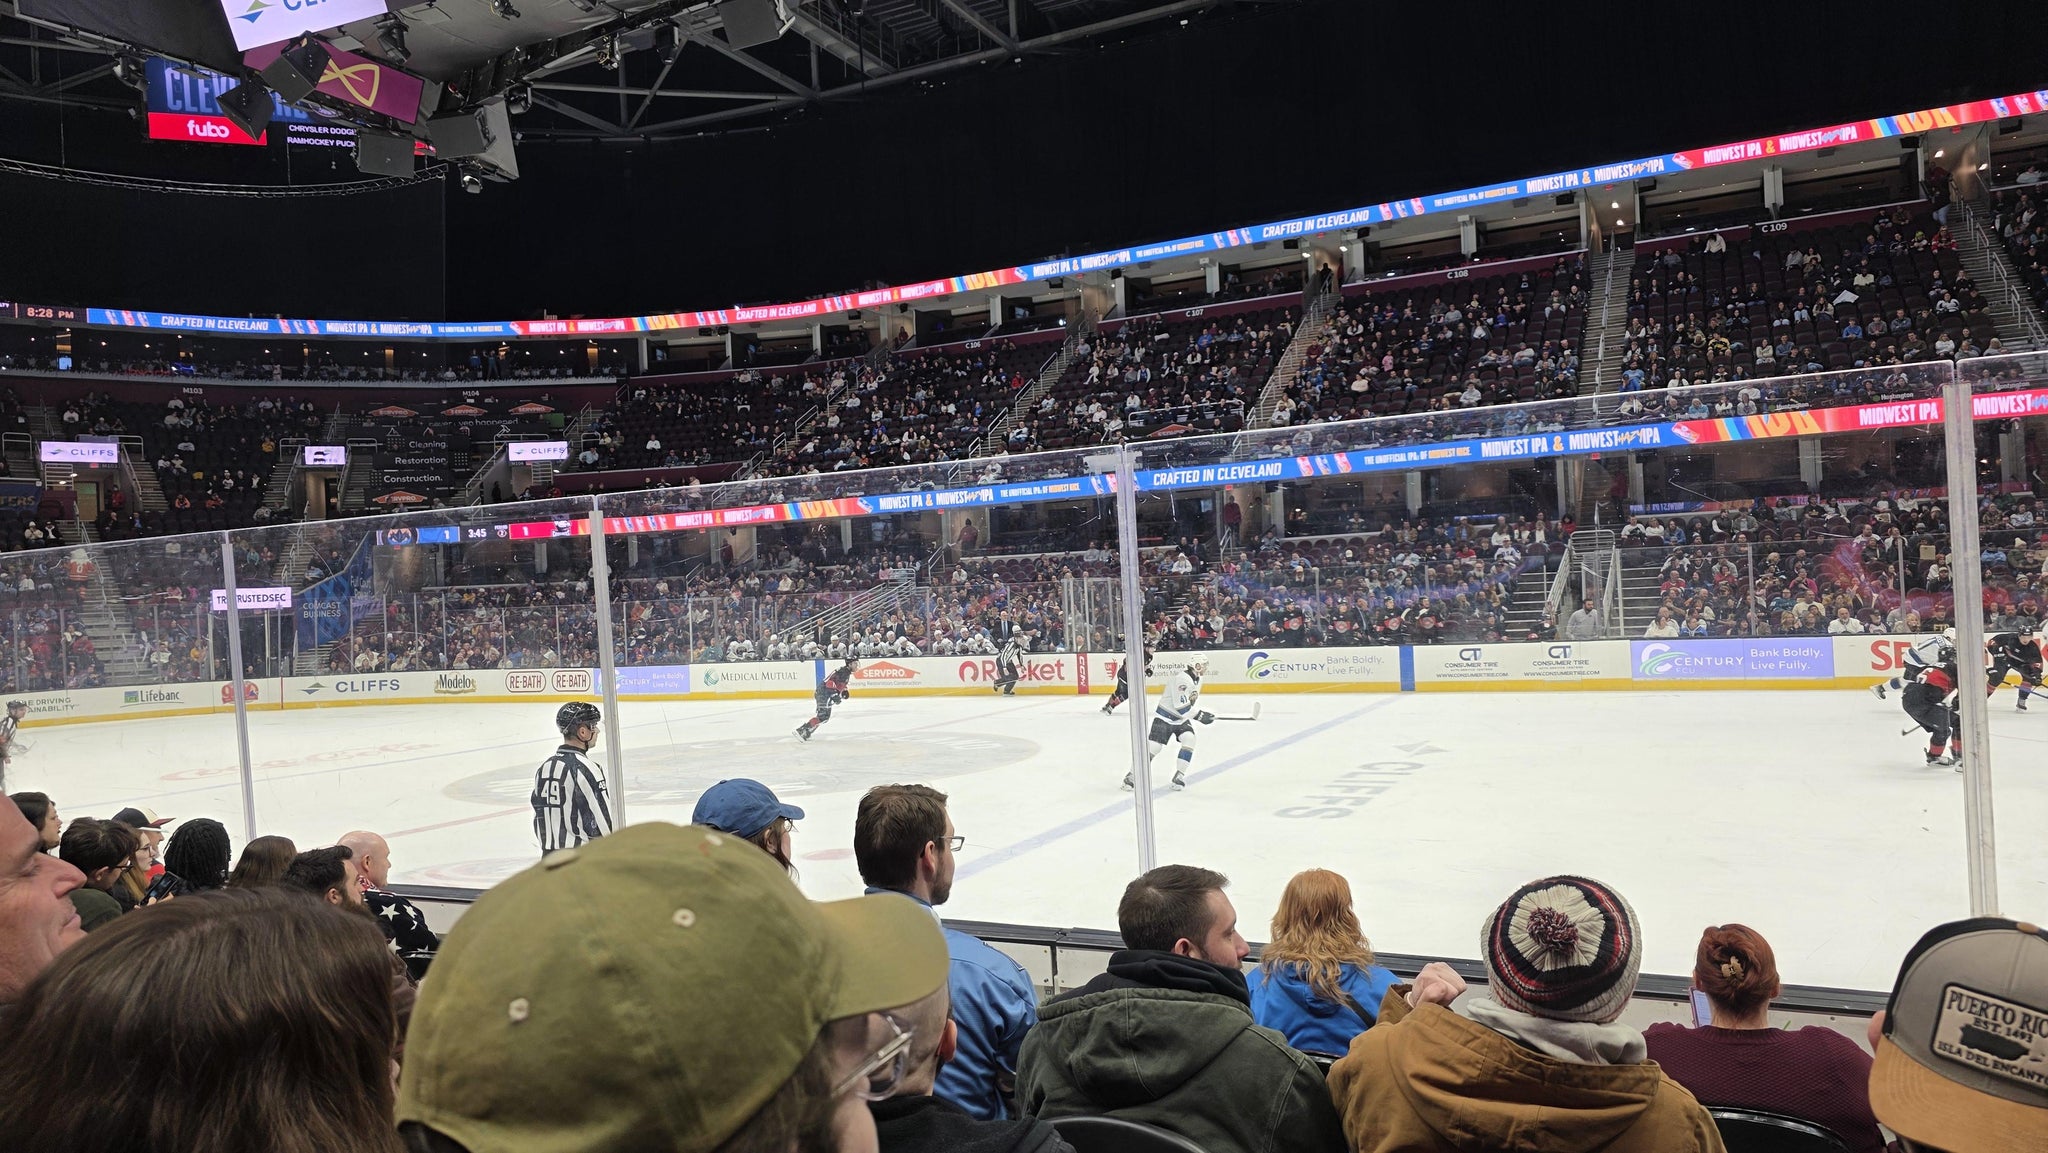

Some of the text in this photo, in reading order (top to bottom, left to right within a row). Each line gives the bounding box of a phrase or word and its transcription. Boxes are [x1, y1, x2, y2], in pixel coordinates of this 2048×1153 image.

[187, 119, 230, 138] fubo
[289, 124, 329, 135] CHRYSLER
[287, 136, 334, 146] RAMHOCKEY
[1704, 126, 1858, 164] MIDWEST IPA & MIDWEST IPA
[1526, 158, 1665, 193] MIDWEST IPA & MIDWEST IPA
[1263, 210, 1370, 238] CRAFTED IN CLEVELAND
[1770, 222, 1788, 232] 109
[1033, 263, 1060, 277] MIDWEST
[1060, 261, 1070, 273] IPA
[1081, 255, 1109, 271] MIDWEST
[1454, 269, 1469, 279] 108
[26, 308, 74, 319] 8:28 PM
[736, 303, 817, 320] CRAFTED IN CLEVELAND
[1191, 308, 1204, 317] 107
[161, 315, 269, 331] CRAFTED IN CLEVELAND
[326, 322, 357, 333] MIDWEST
[357, 322, 368, 334] IPA
[380, 323, 410, 334] MIDWEST
[183, 387, 203, 395] M103
[1859, 404, 1917, 427] MIDWEST
[1918, 402, 1939, 421] IPA
[1973, 394, 2033, 417] MIDWEST
[409, 440, 448, 450] Cleaning.
[1481, 440, 1530, 458] MIDWEST
[1531, 437, 1548, 453] IPA
[1553, 436, 1563, 451] &
[1569, 430, 1619, 450] MIDWEST
[1641, 427, 1660, 444] IPA
[71, 448, 114, 457] CLIFFS
[530, 446, 565, 455] CLIFFS
[383, 473, 443, 483] Construction.
[1153, 462, 1282, 486] CRAFTED IN CLEVELAND
[880, 488, 994, 510] MIDWEST IPA & MIDWEST IPA
[675, 512, 703, 526] MIDWEST
[703, 511, 713, 524] IPA
[444, 529, 450, 540] 1
[468, 528, 487, 538] 3:45
[522, 526, 529, 536] 1
[303, 602, 341, 610] COMCAST
[303, 610, 341, 618] BUSINESS
[1751, 648, 1824, 658] Bank Boldly.
[1326, 655, 1385, 665] Bank Boldly.
[1674, 657, 1744, 667] CENTURY
[1751, 660, 1811, 671] Live Fully.
[982, 659, 1065, 681] Rcket
[1077, 656, 1087, 687] CCM
[1157, 661, 1186, 671] Hospitals
[1272, 663, 1326, 672] CENTURY
[1327, 666, 1374, 676] Live Fully.
[1676, 667, 1696, 675] FCU
[721, 670, 797, 681] MEDICAL MUTUAL
[863, 668, 906, 678] SERVPRO
[335, 678, 400, 693] CLIFFS
[439, 673, 471, 688] Modelo
[509, 674, 542, 690] RE-BATH
[556, 674, 587, 689] RE-BATH
[621, 678, 650, 686] CENTURY
[36, 697, 71, 705] DRIVING
[140, 690, 180, 703] Lifebanc
[28, 703, 74, 714] AINABILITY
[541, 780, 561, 805] 49
[1273, 760, 1426, 820] CLIFFS
[1947, 990, 2016, 1026] PUERTO
[1973, 1016, 2034, 1044] EST. 1493
[1937, 1041, 1964, 1058] ISLA
[1965, 1049, 1990, 1067] DEL
